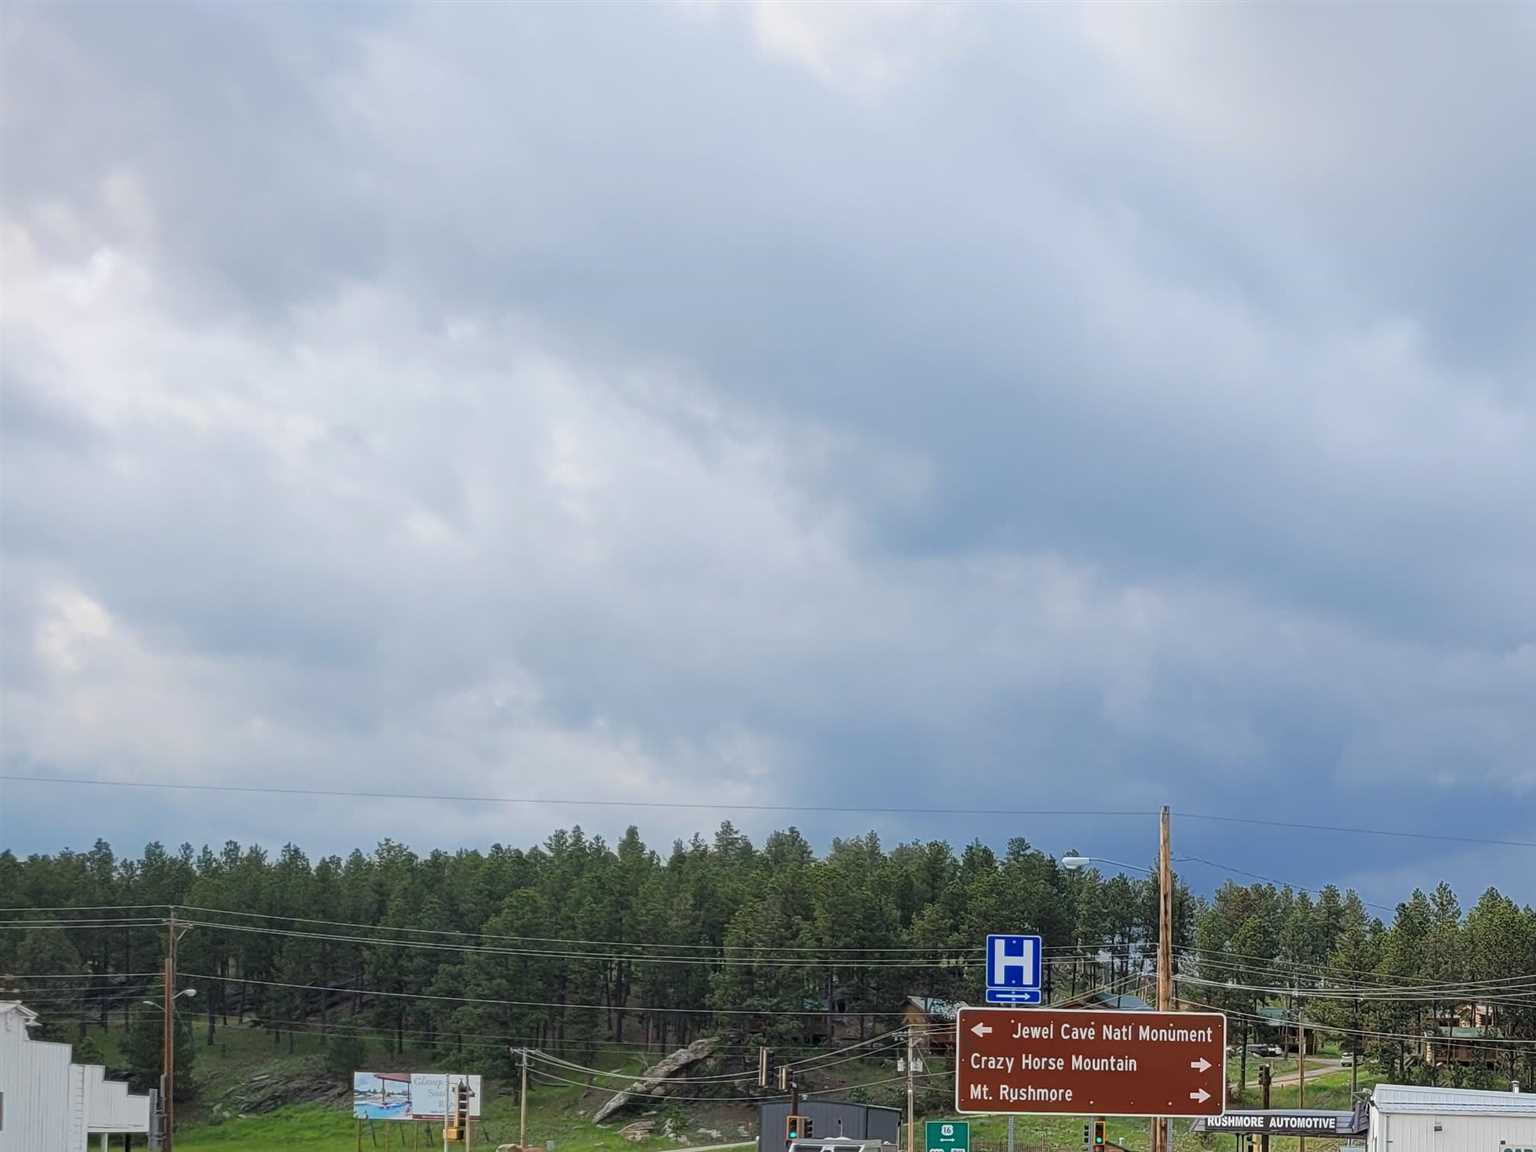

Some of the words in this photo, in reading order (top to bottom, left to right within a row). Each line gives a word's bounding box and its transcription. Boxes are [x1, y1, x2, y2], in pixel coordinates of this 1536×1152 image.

[995, 939, 1033, 985] H
[1012, 1022, 1054, 1040] Jewel
[1060, 1023, 1096, 1041] Cave
[1102, 1024, 1133, 1041] Natl
[1138, 1025, 1213, 1043] Monument
[970, 1053, 1015, 1073] Crazy
[1021, 1054, 1065, 1071] Horse
[1071, 1055, 1137, 1072] Mountain
[970, 1084, 993, 1101] Mt.
[999, 1085, 1073, 1102] Rushmore
[1206, 1115, 1264, 1128] RUSHMORE
[1269, 1117, 1336, 1129] AUTOMOTIVE
